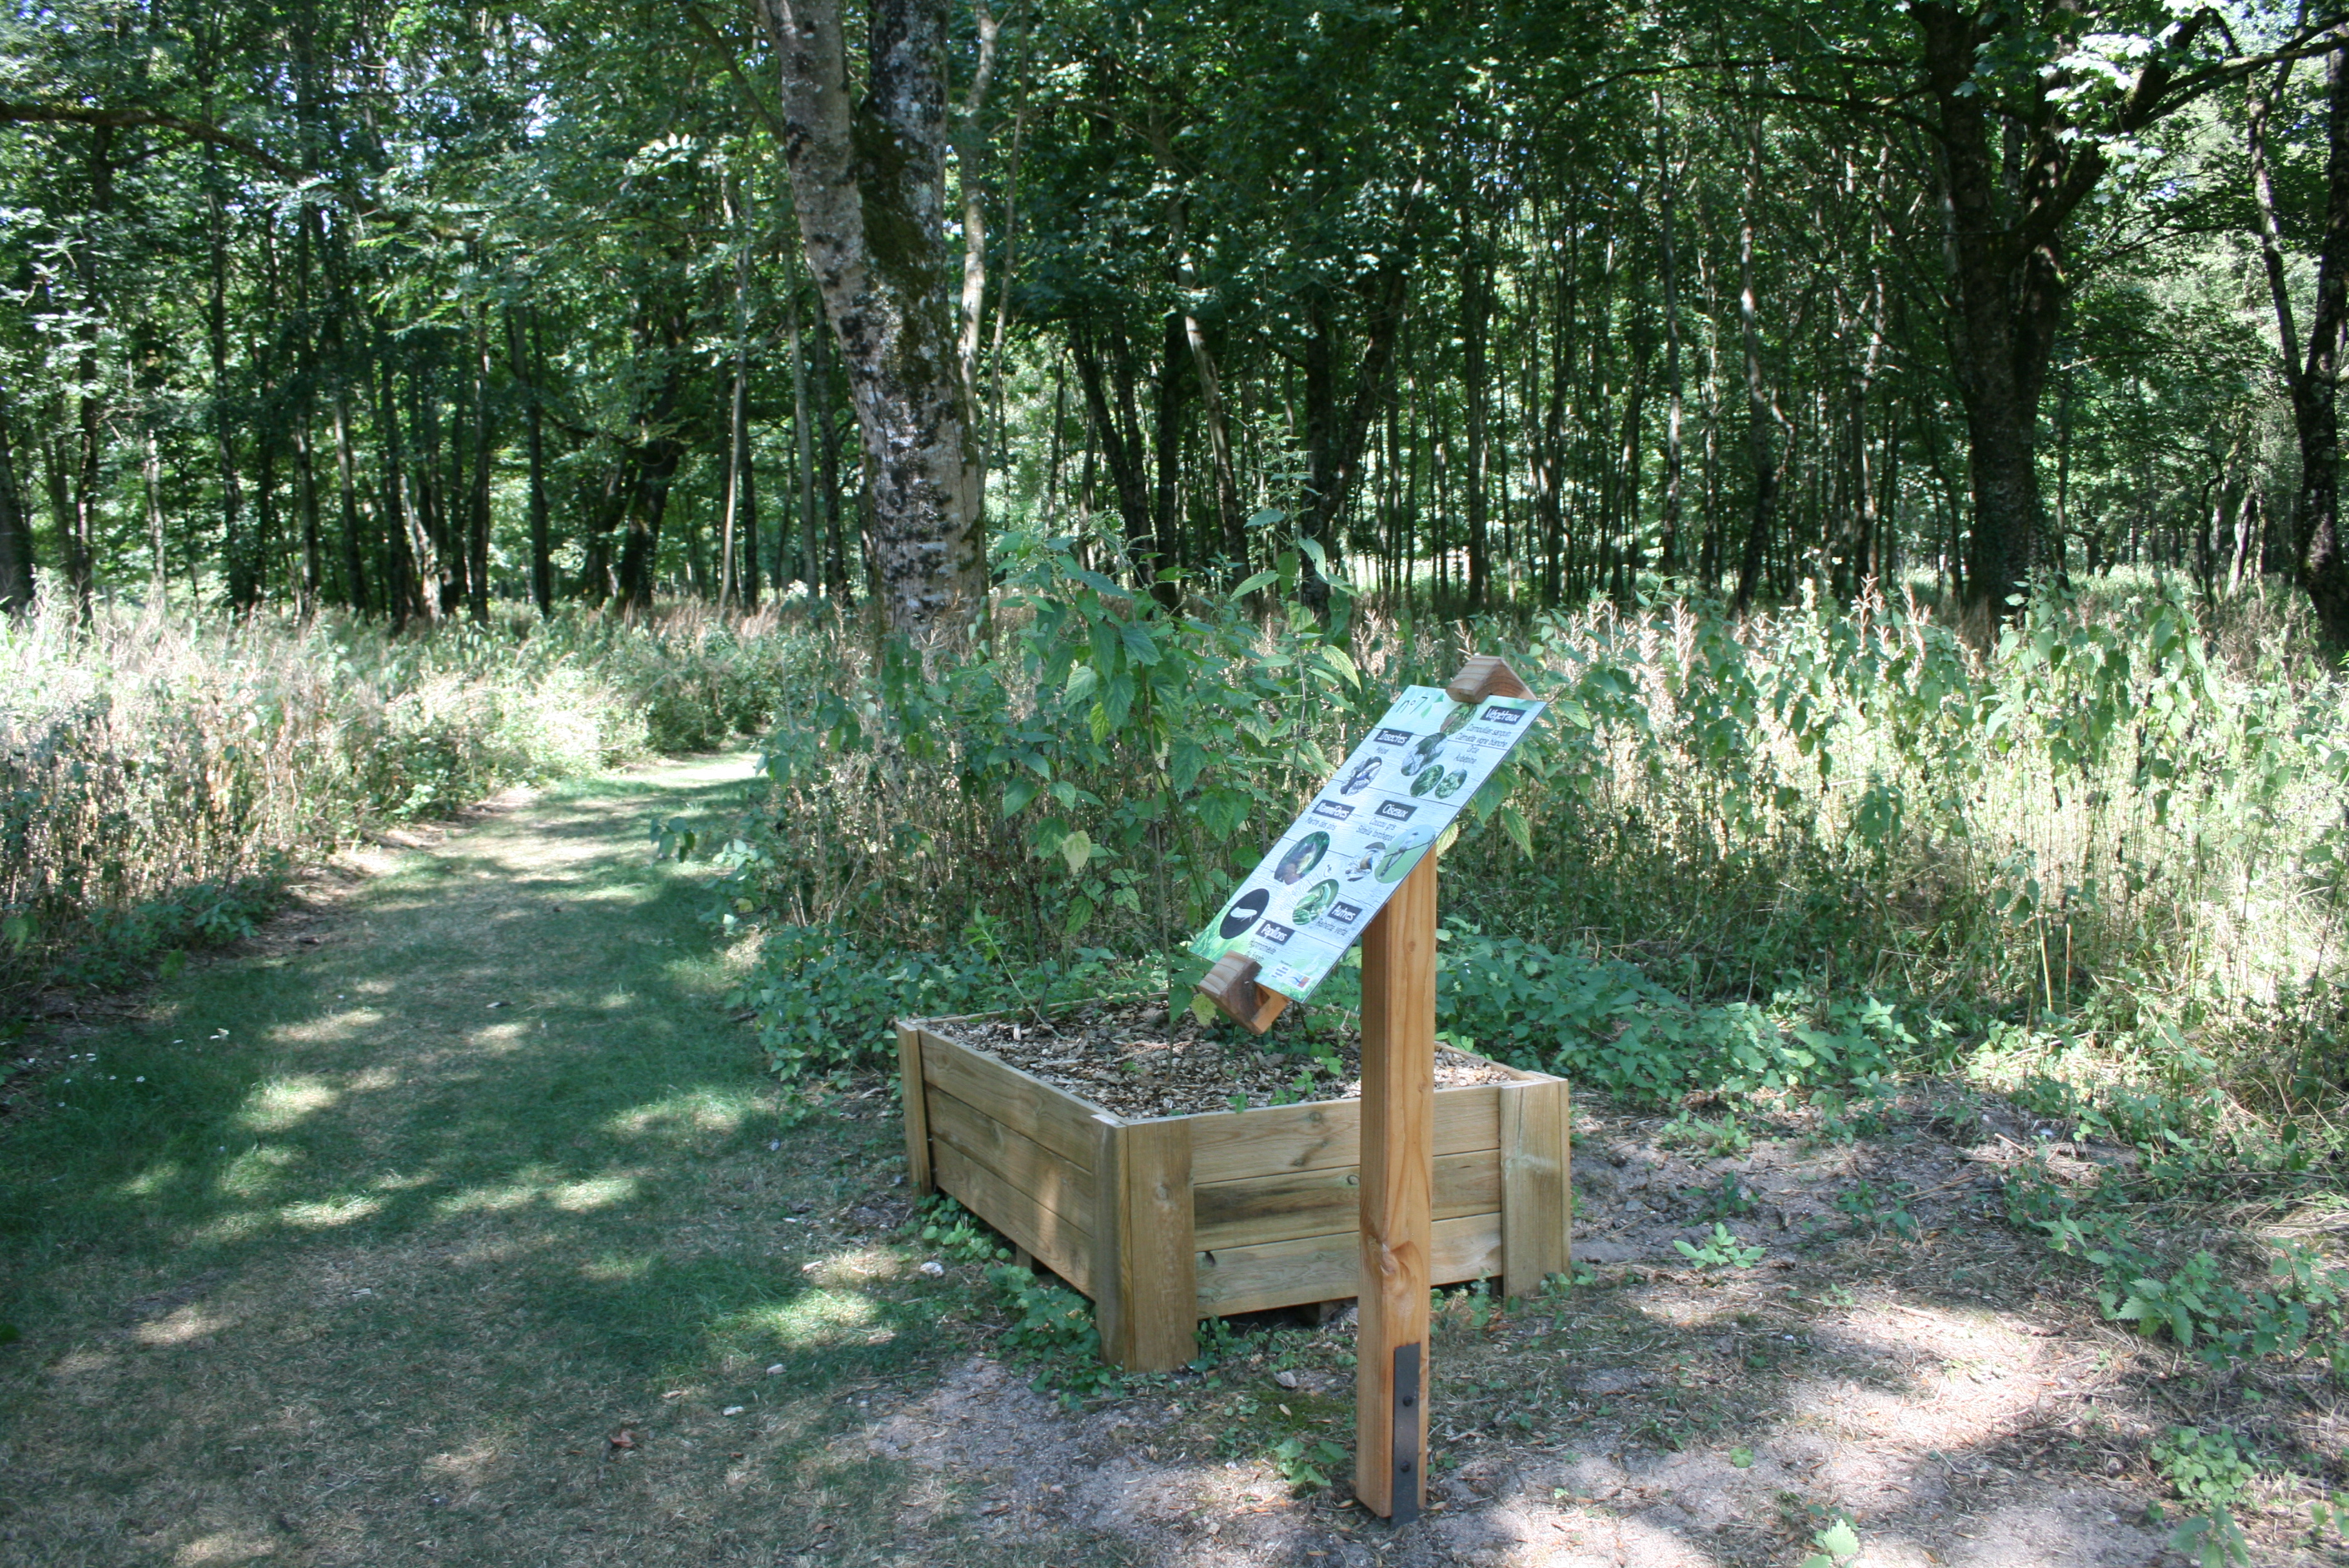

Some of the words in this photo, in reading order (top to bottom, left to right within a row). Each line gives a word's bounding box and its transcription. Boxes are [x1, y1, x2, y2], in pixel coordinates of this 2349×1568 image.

[1486, 708, 1521, 722] Végétaux
[1377, 730, 1408, 744] Insectes
[1382, 803, 1409, 818] Oiseaux
[1330, 905, 1356, 922] Autres
[1260, 923, 1287, 942] Papillons
